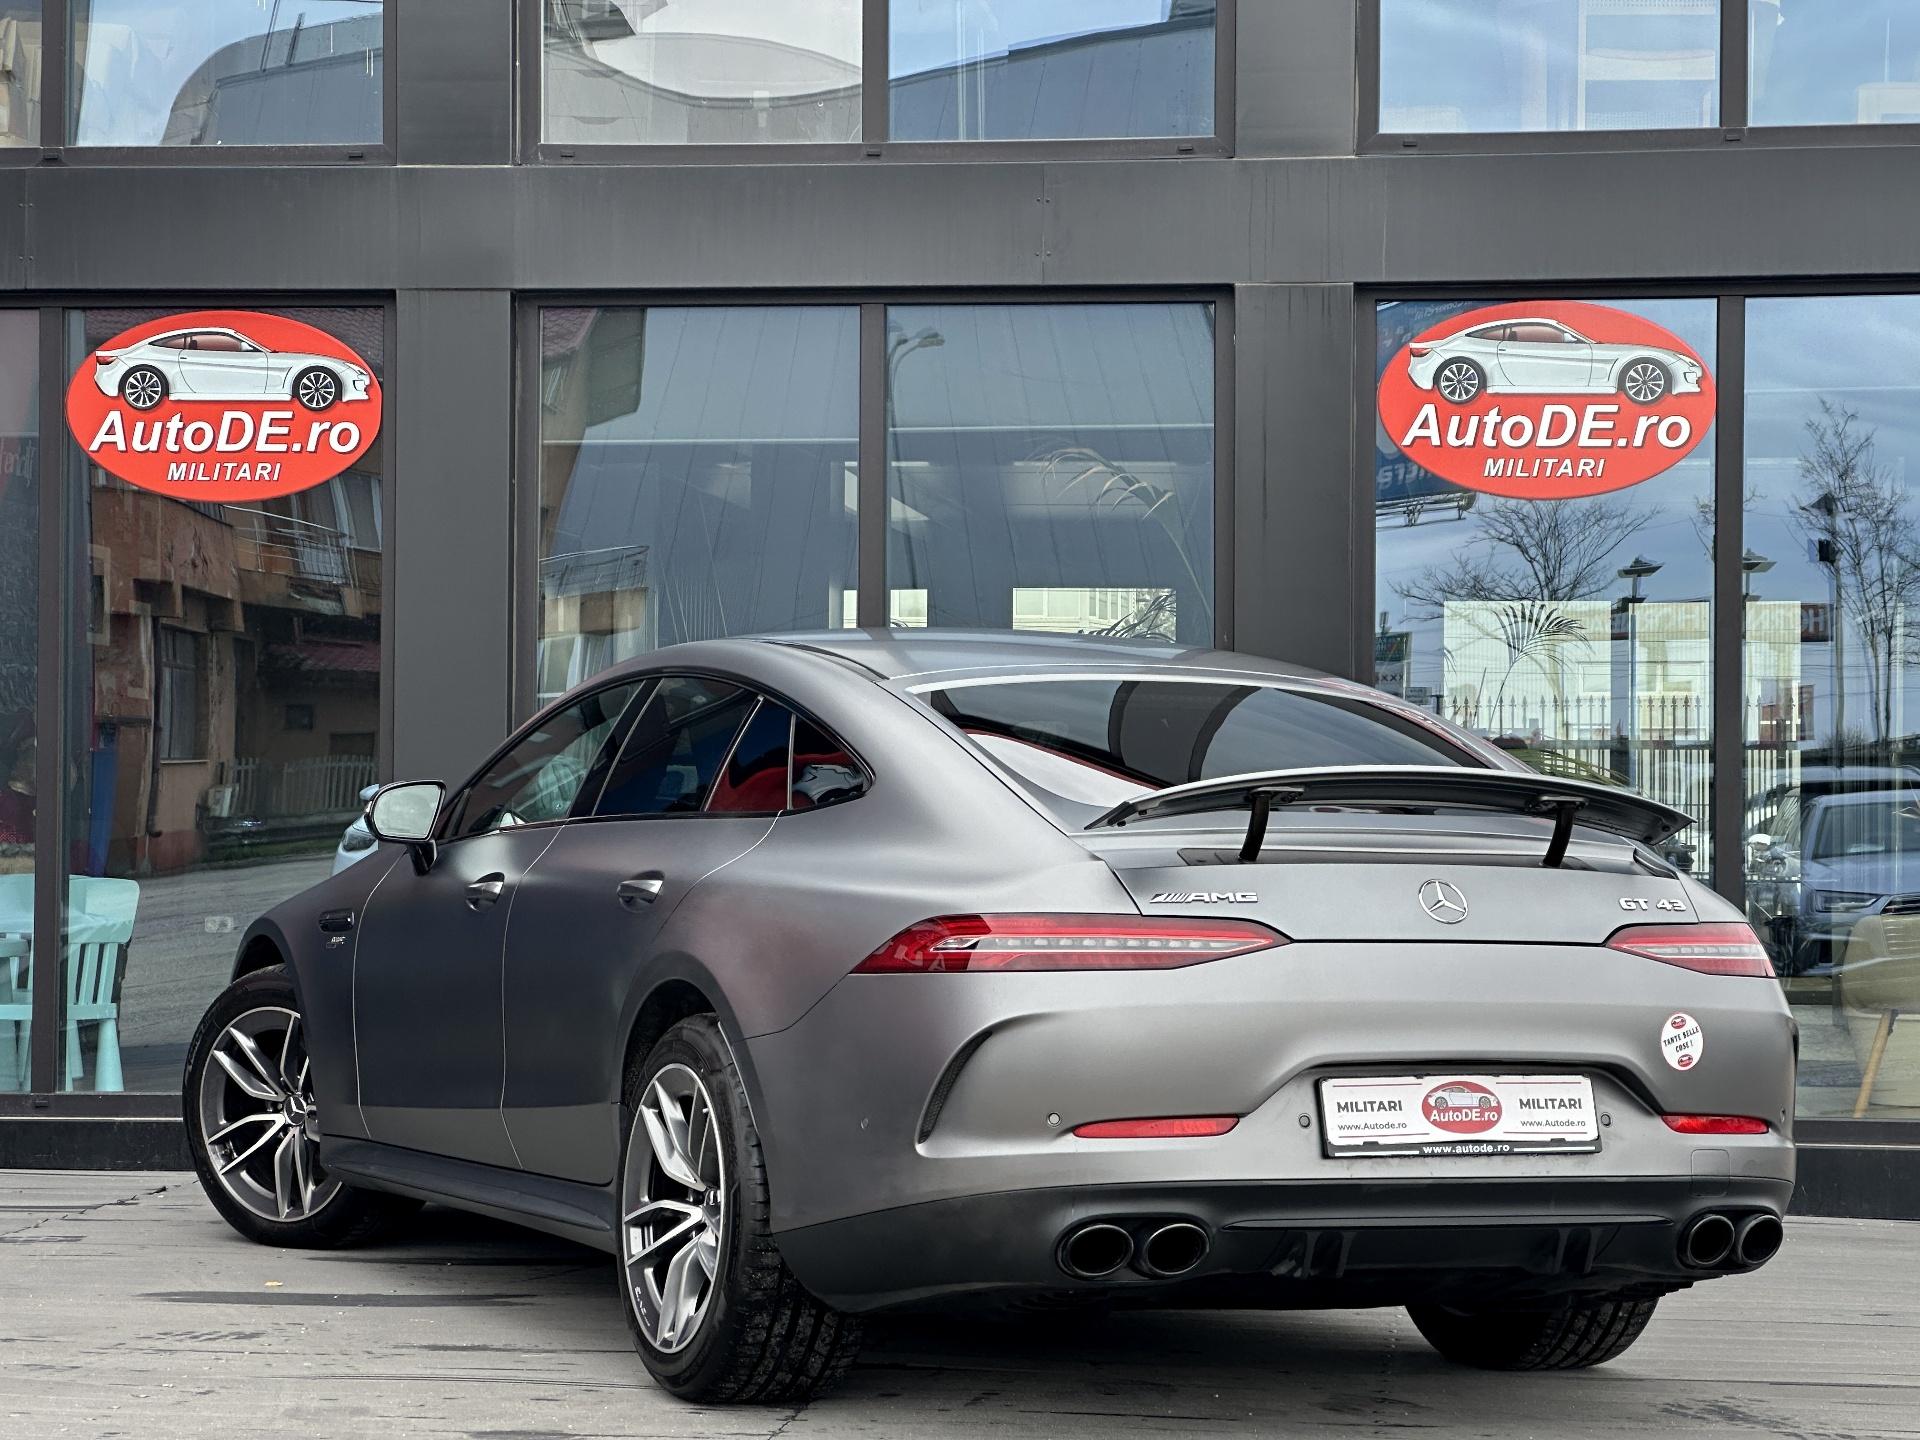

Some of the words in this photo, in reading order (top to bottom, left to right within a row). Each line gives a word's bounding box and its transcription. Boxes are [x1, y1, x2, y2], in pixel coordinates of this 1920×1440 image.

[89, 410, 361, 453] AutoDE.ro
[1401, 404, 1691, 448] AutoDE.ro
[166, 462, 282, 482] MILITARI
[1483, 458, 1606, 478] MILITARI
[1619, 897, 1649, 911] GT
[1656, 899, 1687, 912] 43
[1663, 1034, 1681, 1047] TANTE
[1675, 1041, 1689, 1053] COSE
[1336, 1100, 1403, 1113] MILITARI
[1518, 1098, 1583, 1110] MILITARI
[1429, 1108, 1499, 1123] AutoDE.ro
[1337, 1121, 1408, 1131] www.Autode.ro
[1520, 1118, 1586, 1128] www.Autode.ro
[1422, 1143, 1510, 1154] www.autode.ro
